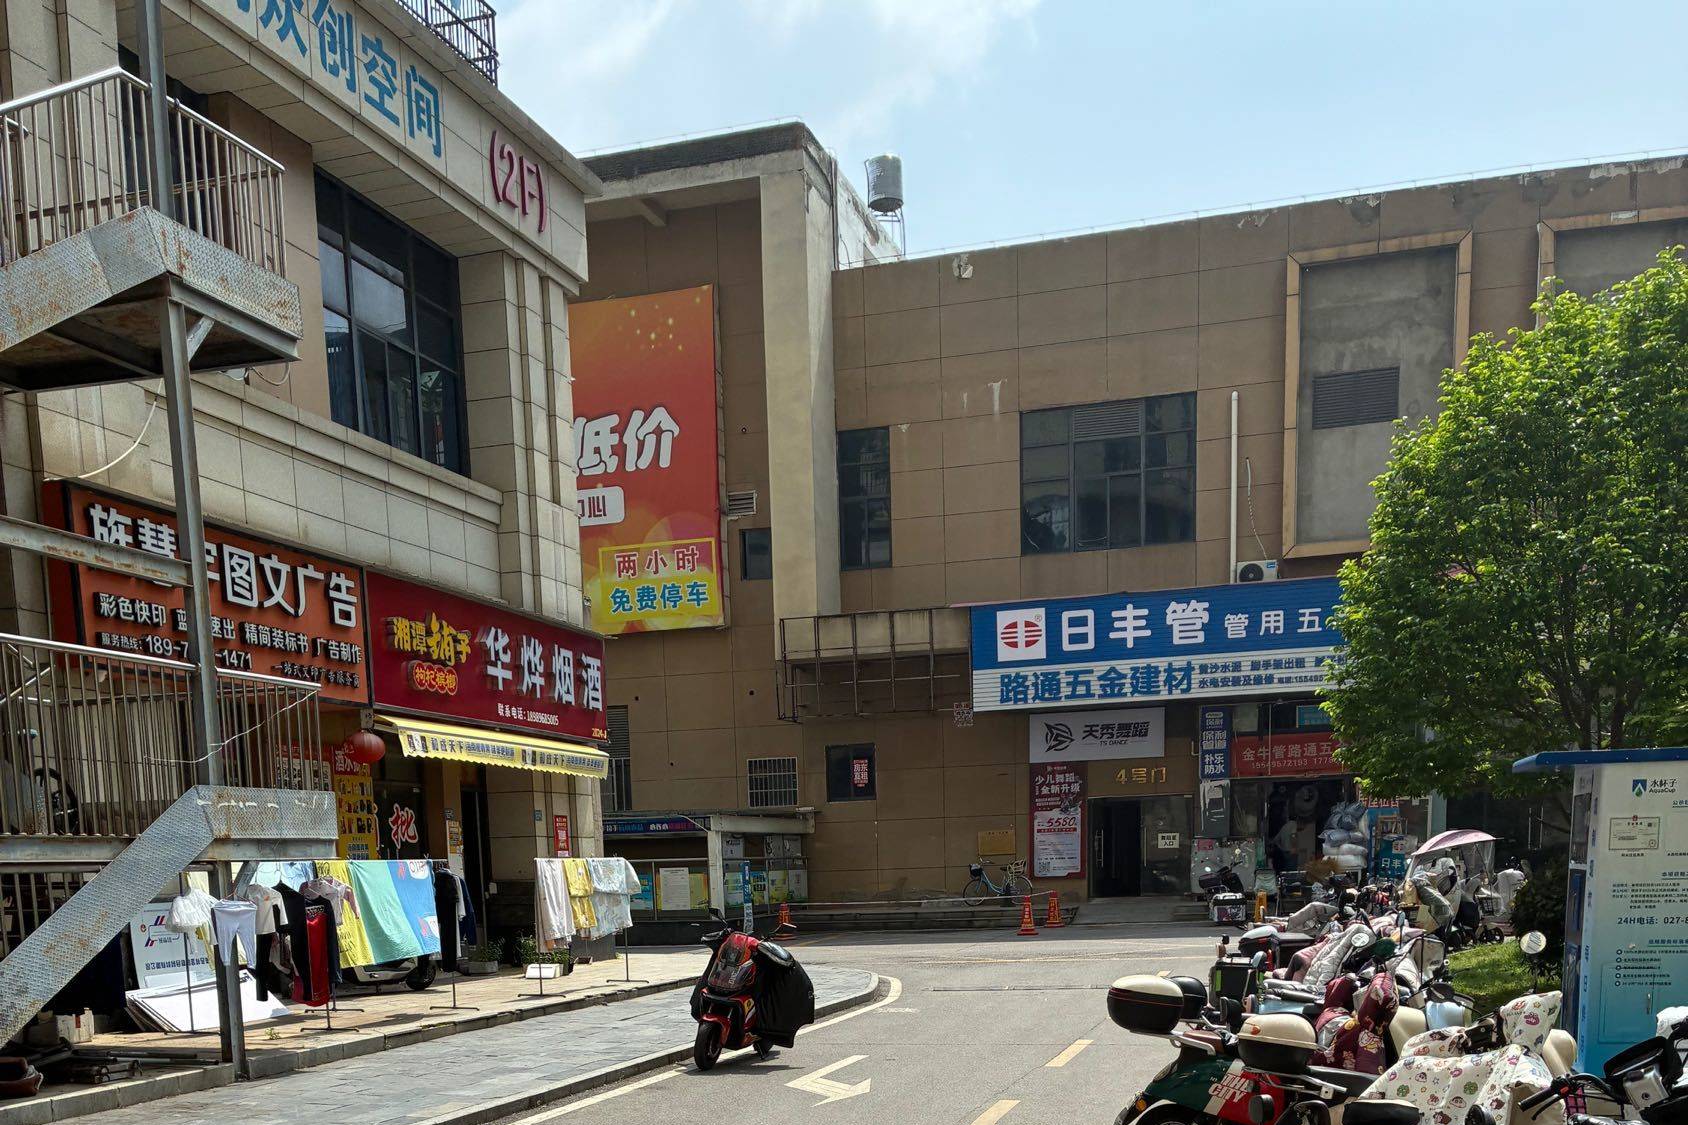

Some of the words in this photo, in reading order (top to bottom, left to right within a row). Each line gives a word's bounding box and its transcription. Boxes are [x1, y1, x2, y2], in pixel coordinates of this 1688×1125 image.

[237, 0, 442, 158] 众创空间
[615, 546, 700, 579] 两小时
[610, 580, 709, 614] 免费停车
[99, 593, 167, 627] 彩色快印
[316, 637, 362, 665] 广告制作
[1062, 600, 1210, 652] 日丰管
[1225, 606, 1346, 639] 管用五
[393, 612, 472, 667] 湘潭铺子
[485, 626, 603, 712] 华烨烟酒
[1000, 660, 1195, 705] 路通五金建材
[1082, 721, 1150, 741] 天秀舞蹈
[1242, 741, 1333, 761] 金牛管路通五
[1035, 772, 1076, 786] 少儿舞蹈
[1116, 767, 1167, 785] 4号门
[1204, 764, 1225, 774] 防水
[1041, 784, 1081, 796] 全新升级
[1650, 778, 1678, 788] 水杯子
[1047, 816, 1076, 827] 5580
[1617, 916, 1659, 925] 24H电话:
[1208, 1083, 1247, 1103] CITY
